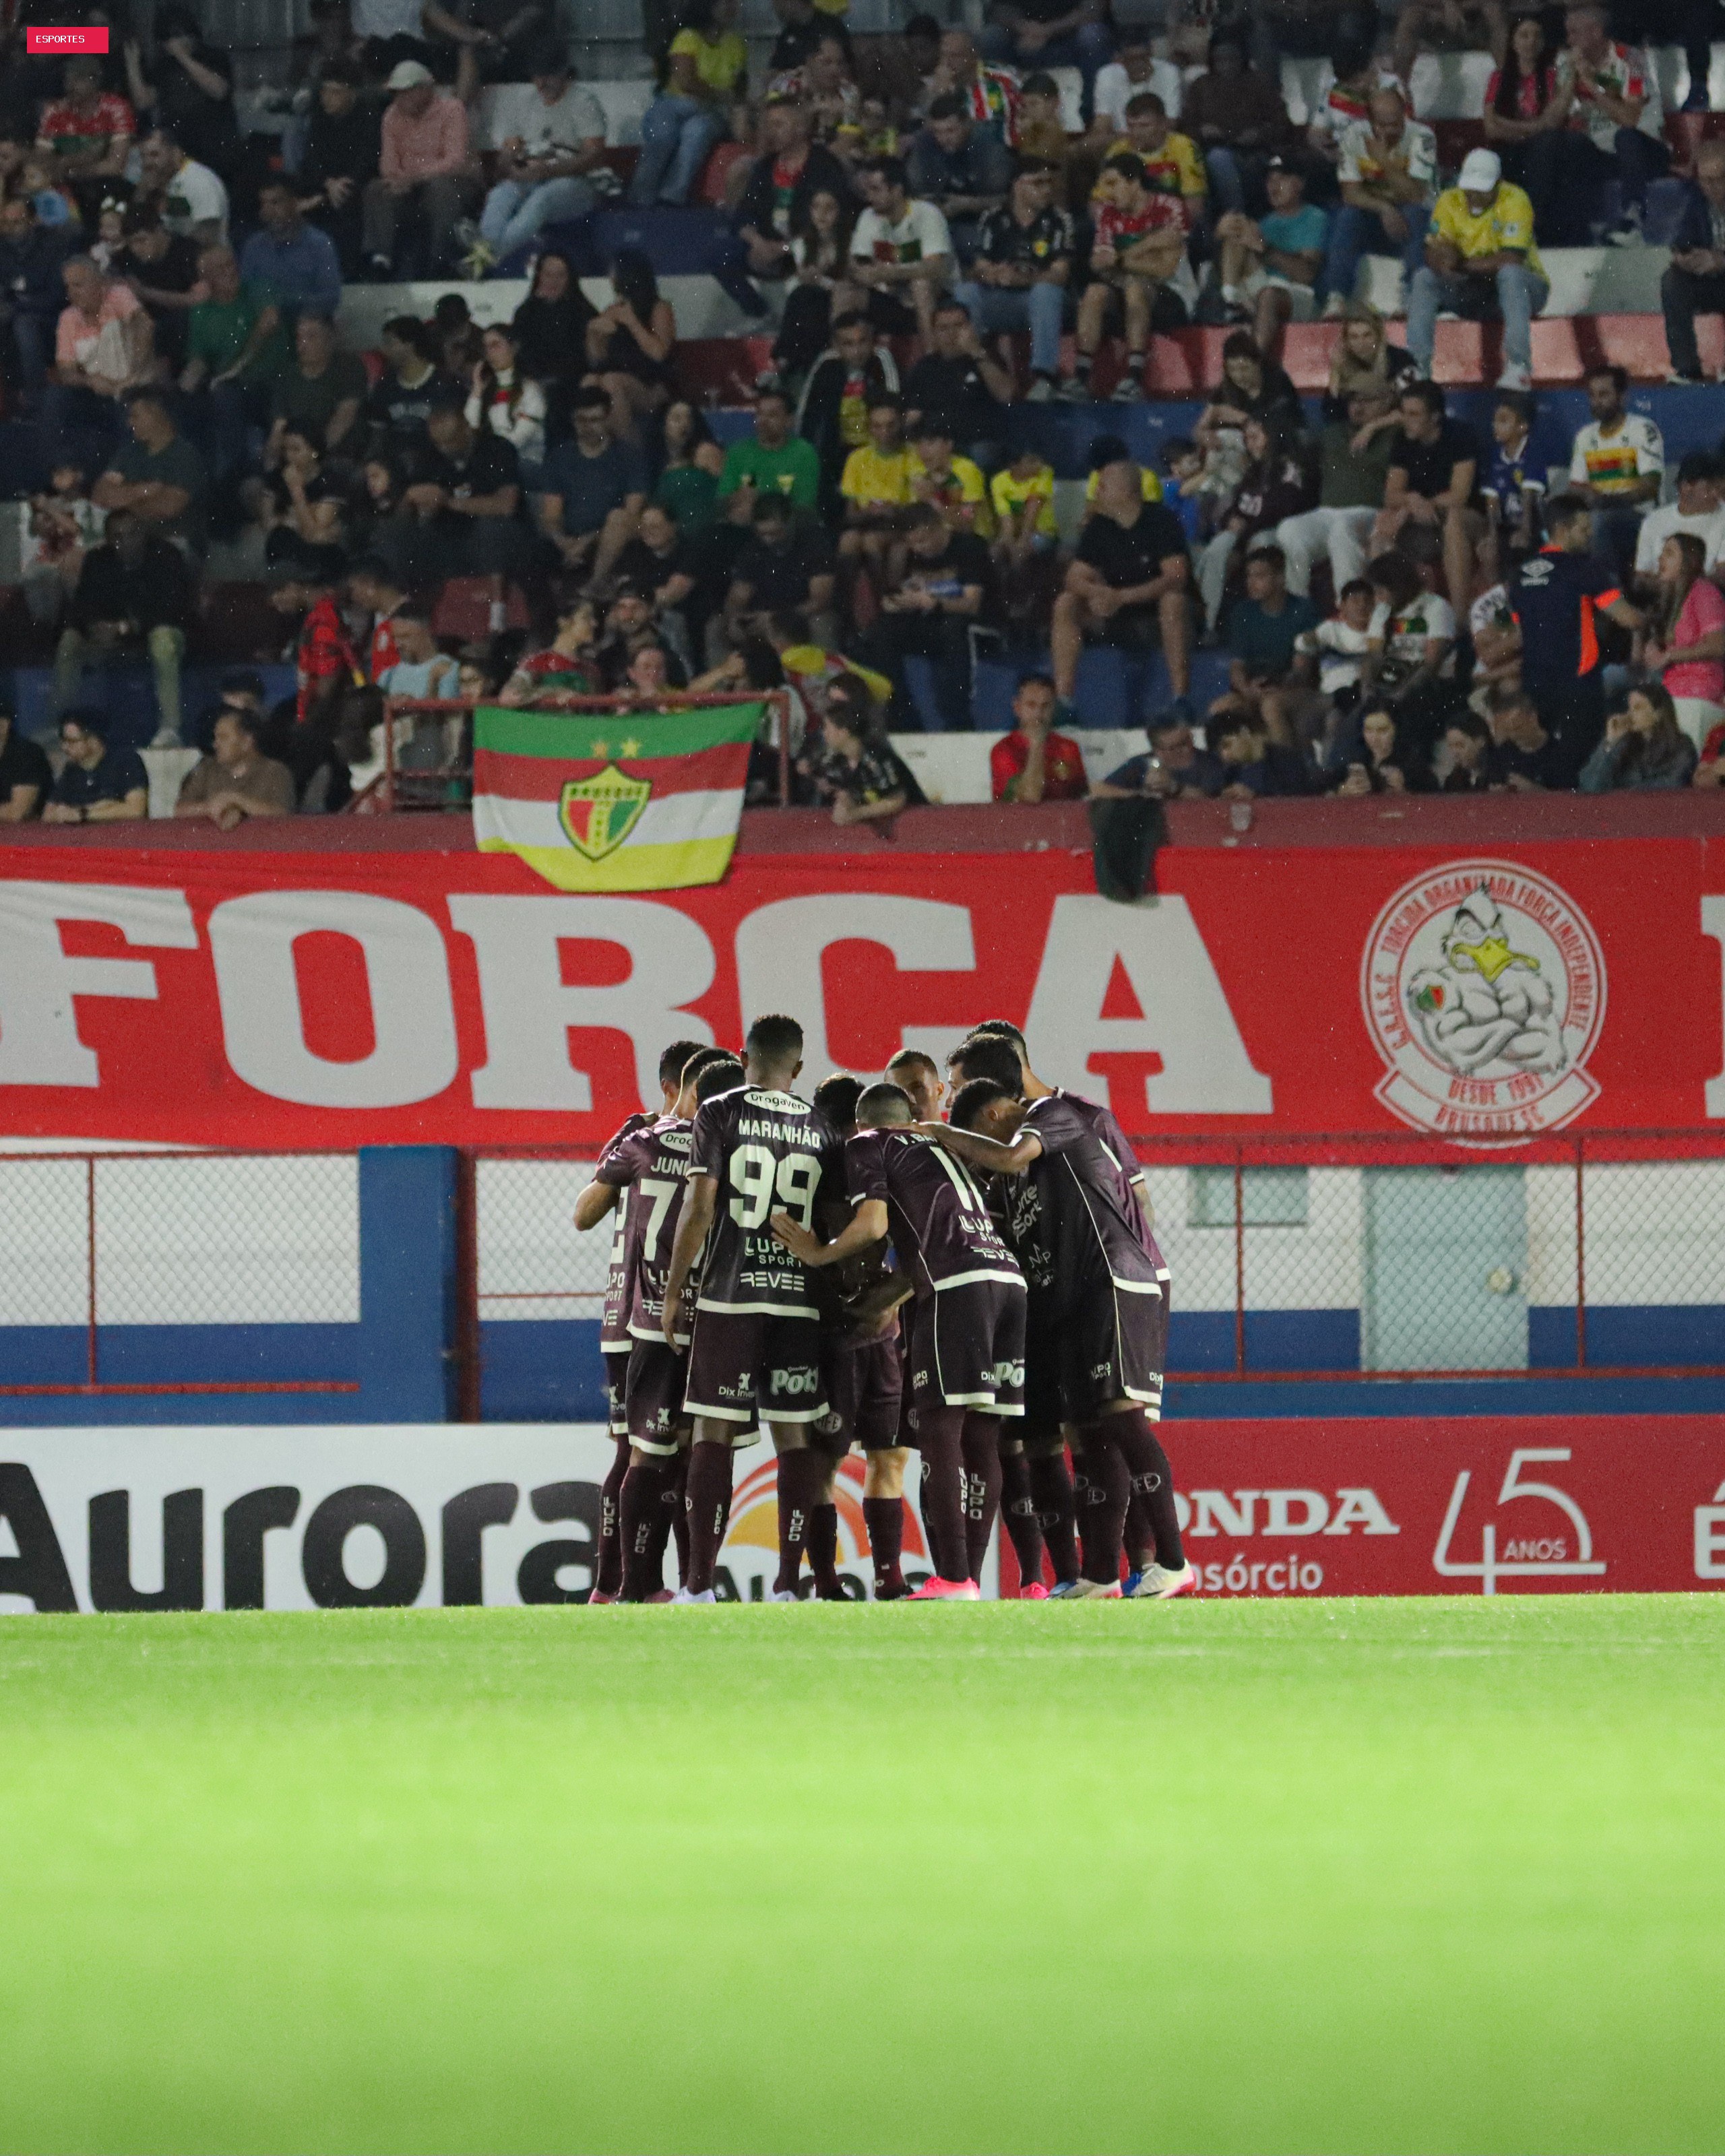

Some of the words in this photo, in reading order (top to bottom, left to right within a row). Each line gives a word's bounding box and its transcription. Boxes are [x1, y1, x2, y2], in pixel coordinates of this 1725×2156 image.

[739, 1118, 821, 1148] MARANHÃO
[729, 1145, 822, 1232] 99
[745, 1236, 798, 1258] LUP
[1173, 1488, 1400, 1537] NDA
[1433, 1448, 1608, 1595] 45
[1503, 1540, 1567, 1560] ANOS
